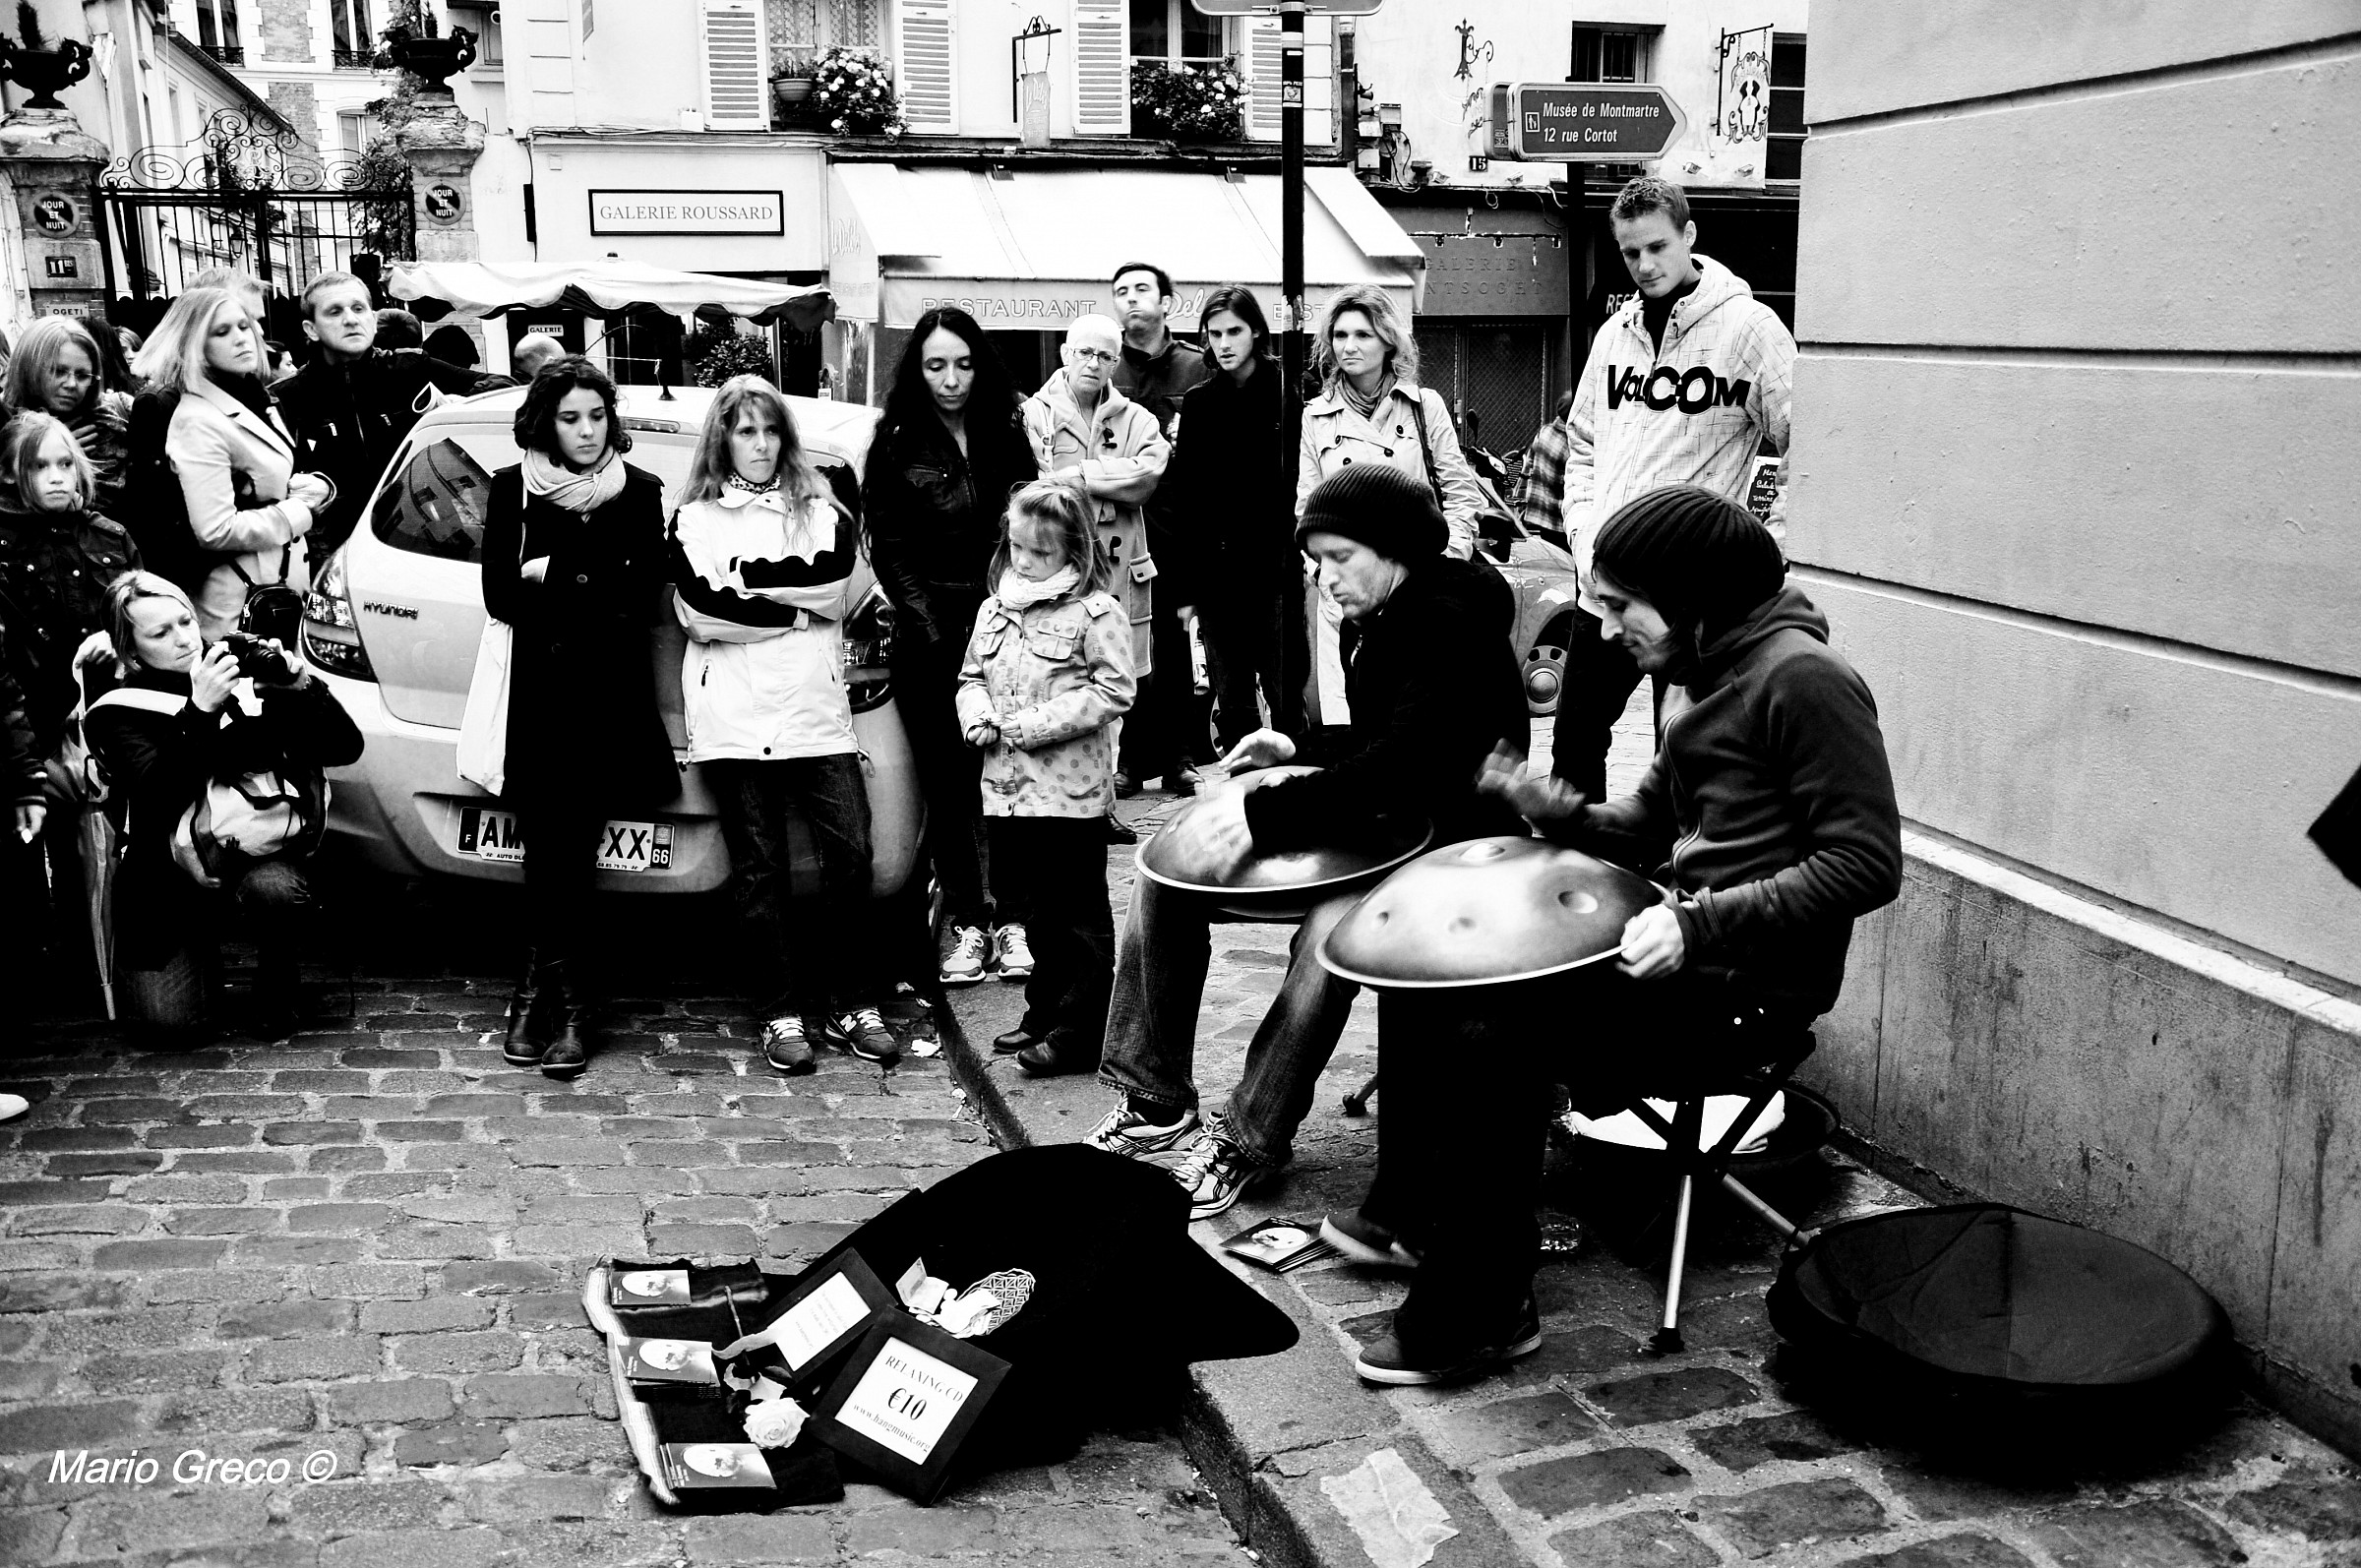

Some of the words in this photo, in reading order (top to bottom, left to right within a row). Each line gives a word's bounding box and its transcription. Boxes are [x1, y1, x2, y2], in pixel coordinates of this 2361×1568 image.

[1543, 102, 1577, 118] Musée
[1582, 102, 1596, 118] de
[1600, 102, 1660, 118] Montmartre
[1544, 128, 1555, 143] 12
[1561, 131, 1578, 143] rue
[1584, 128, 1617, 143] Cortot
[1471, 157, 1486, 171] 15
[432, 189, 453, 198] JOUR
[41, 201, 64, 210] JOUR
[600, 206, 678, 220] GALERIE
[682, 206, 773, 220] ROUSSARD
[49, 211, 59, 219] ET
[1425, 258, 1516, 271] GALERIE
[1607, 364, 1752, 415] VOLCOM
[363, 600, 419, 620] HYUNDAI
[464, 833, 472, 844] F
[651, 848, 670, 865] 66
[884, 1356, 945, 1394] RELAXING
[945, 1387, 963, 1403] CD
[887, 1387, 928, 1420] €10
[853, 1403, 931, 1453] www.hangmusic.org
